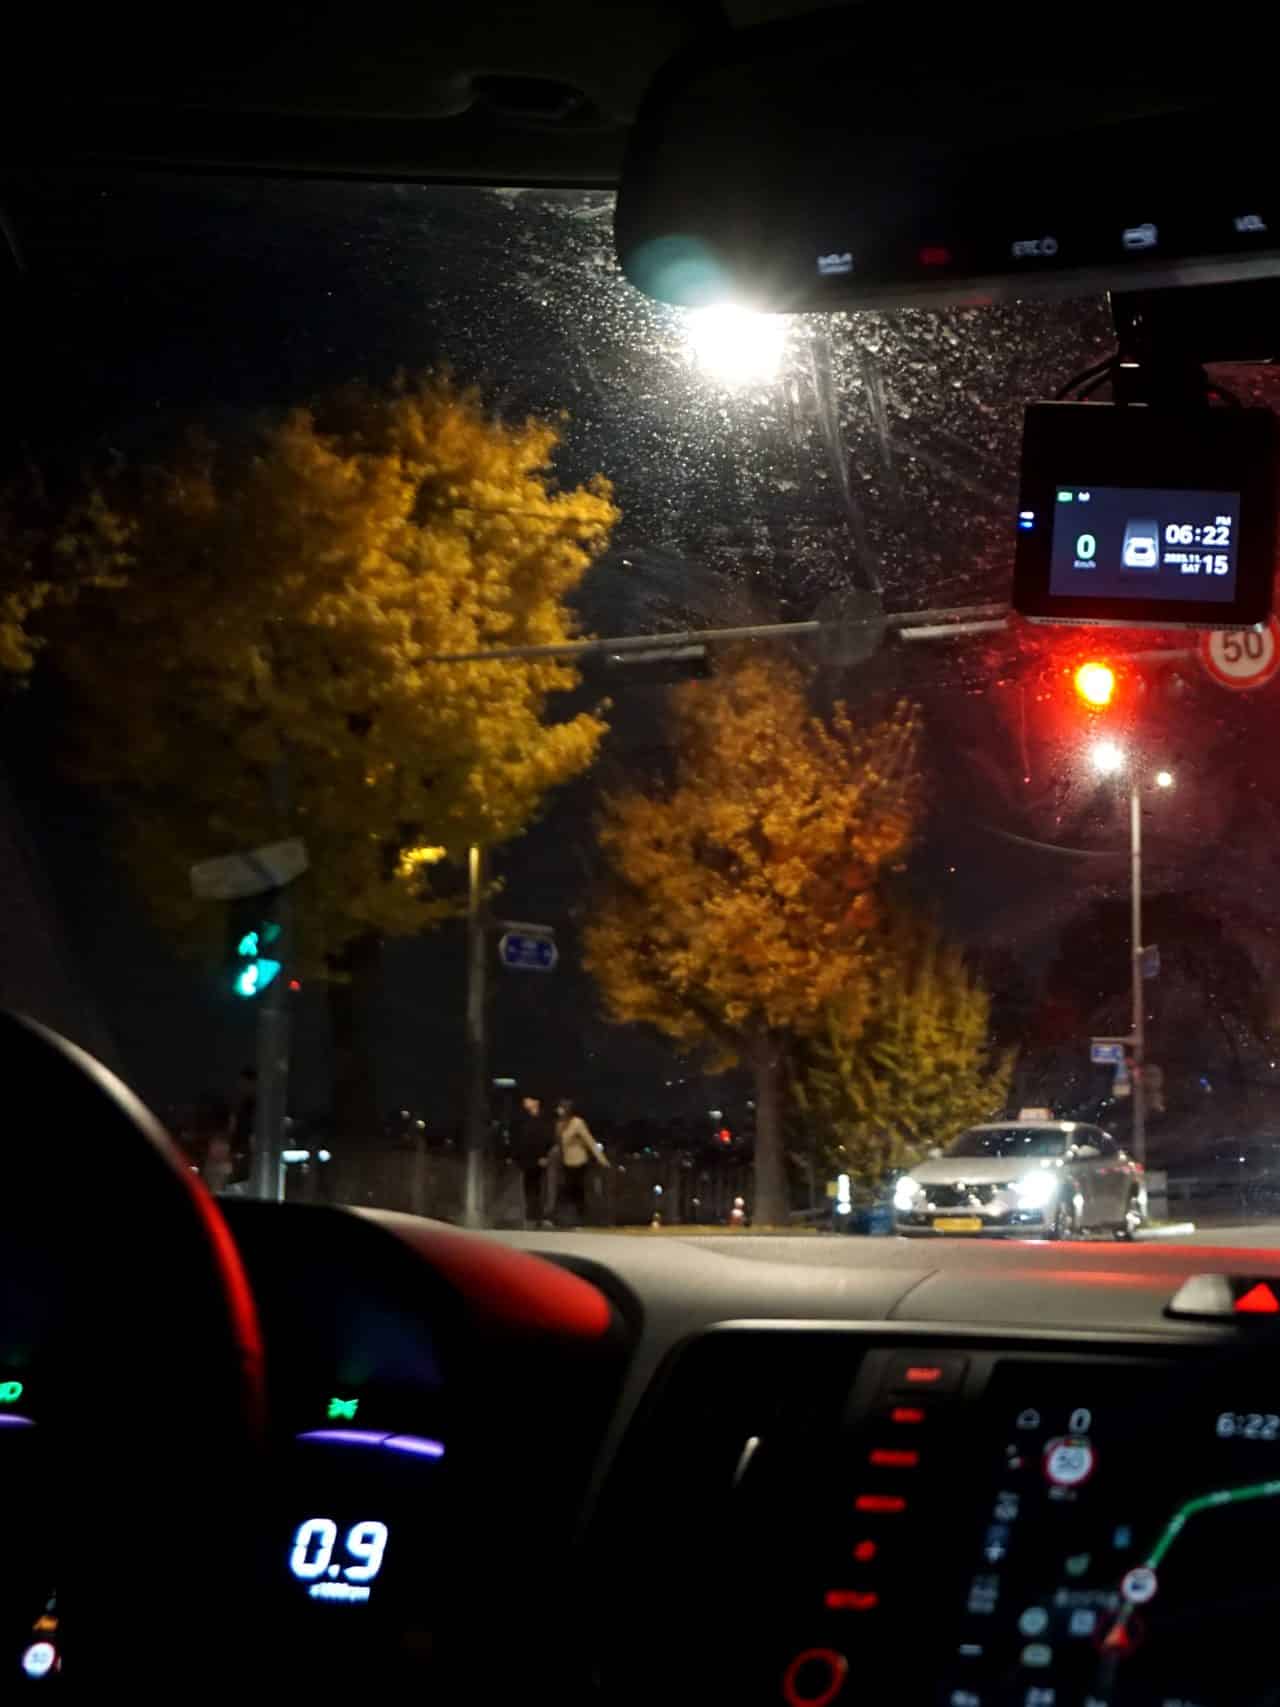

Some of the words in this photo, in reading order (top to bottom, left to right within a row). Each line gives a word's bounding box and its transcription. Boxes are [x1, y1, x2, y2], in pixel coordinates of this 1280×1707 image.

[1076, 533, 1096, 560] 0
[1165, 524, 1230, 546] 06:22
[1180, 563, 1201, 574] SAT
[1202, 554, 1229, 575] 15
[1222, 630, 1264, 664] 50
[1216, 1411, 1280, 1440] 6:22
[290, 1518, 388, 1580] 0.9
